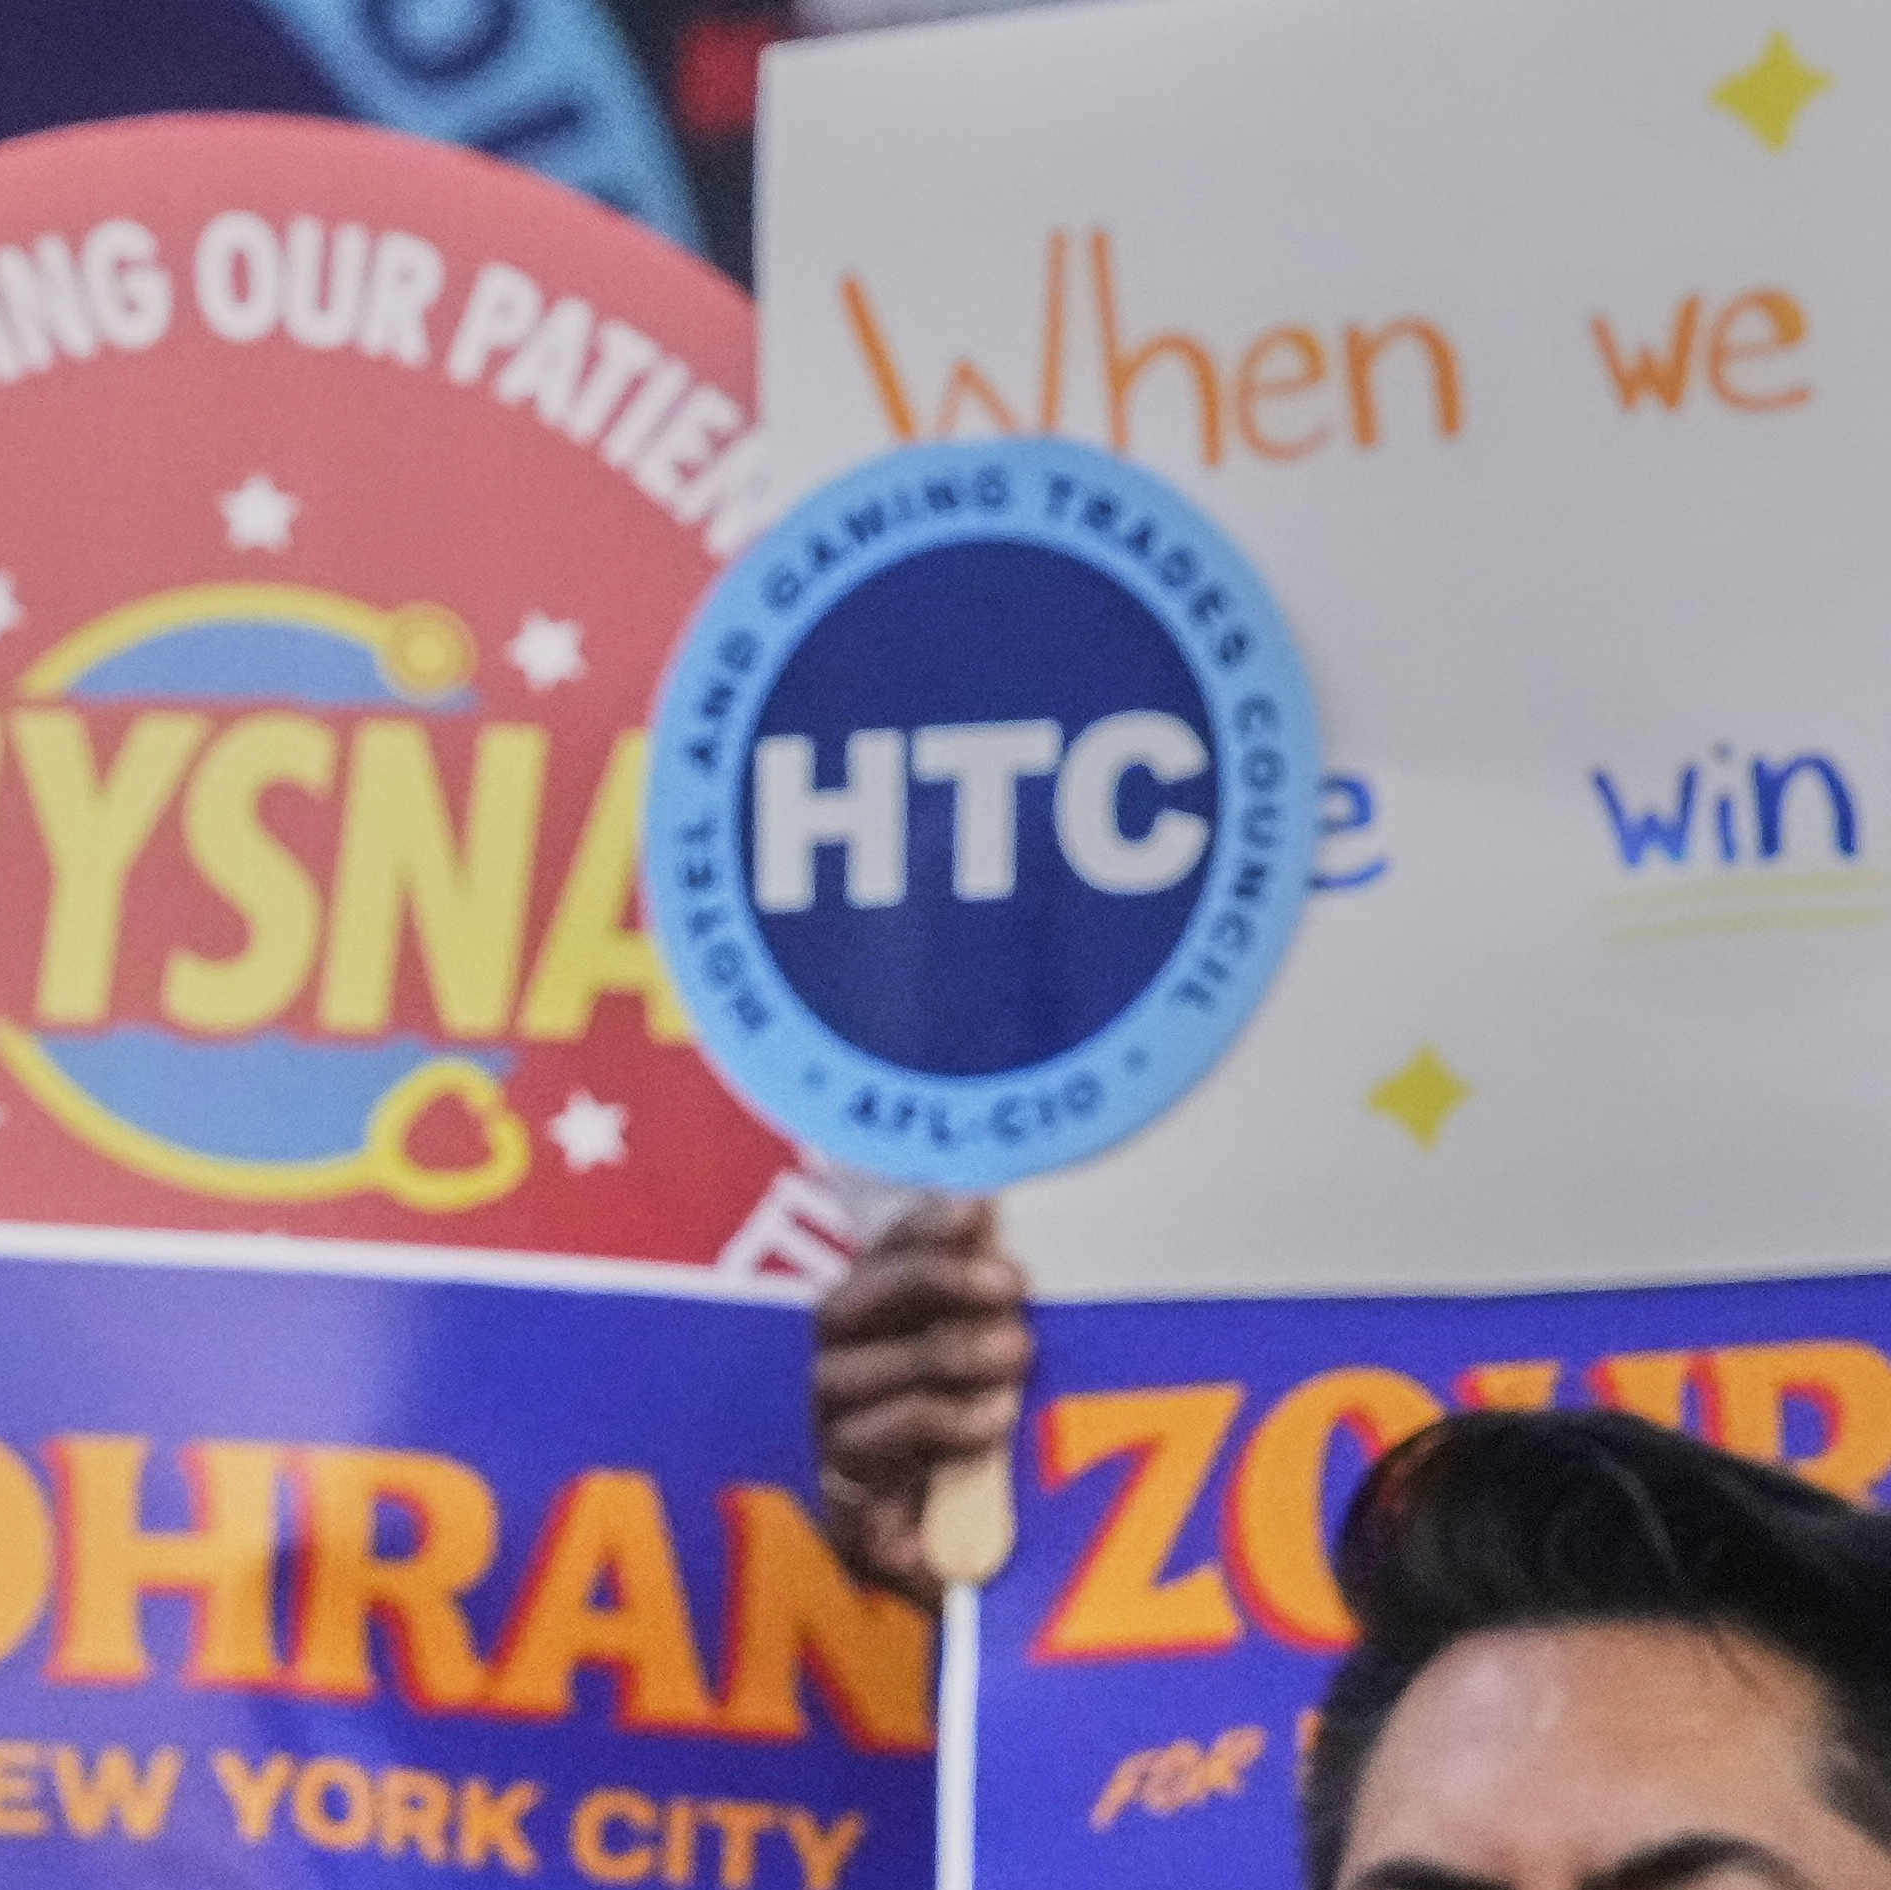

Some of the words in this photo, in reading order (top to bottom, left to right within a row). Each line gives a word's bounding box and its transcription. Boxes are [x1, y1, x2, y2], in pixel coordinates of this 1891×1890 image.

[193, 210, 447, 370] OUR
[446, 260, 781, 560] PATIEN
[837, 225, 1466, 468] When
[1589, 286, 1817, 414] we
[759, 465, 1012, 614] GAMING
[1043, 472, 1251, 670] TRADES
[685, 628, 763, 773] AND
[751, 709, 1213, 916] HTC
[1168, 690, 1287, 1014] COUNCIL
[1591, 742, 1861, 872] win
[678, 815, 772, 1036] HOTEL
[845, 1072, 1107, 1148] AFL-CIO
[209, 1748, 547, 1876] YORK
